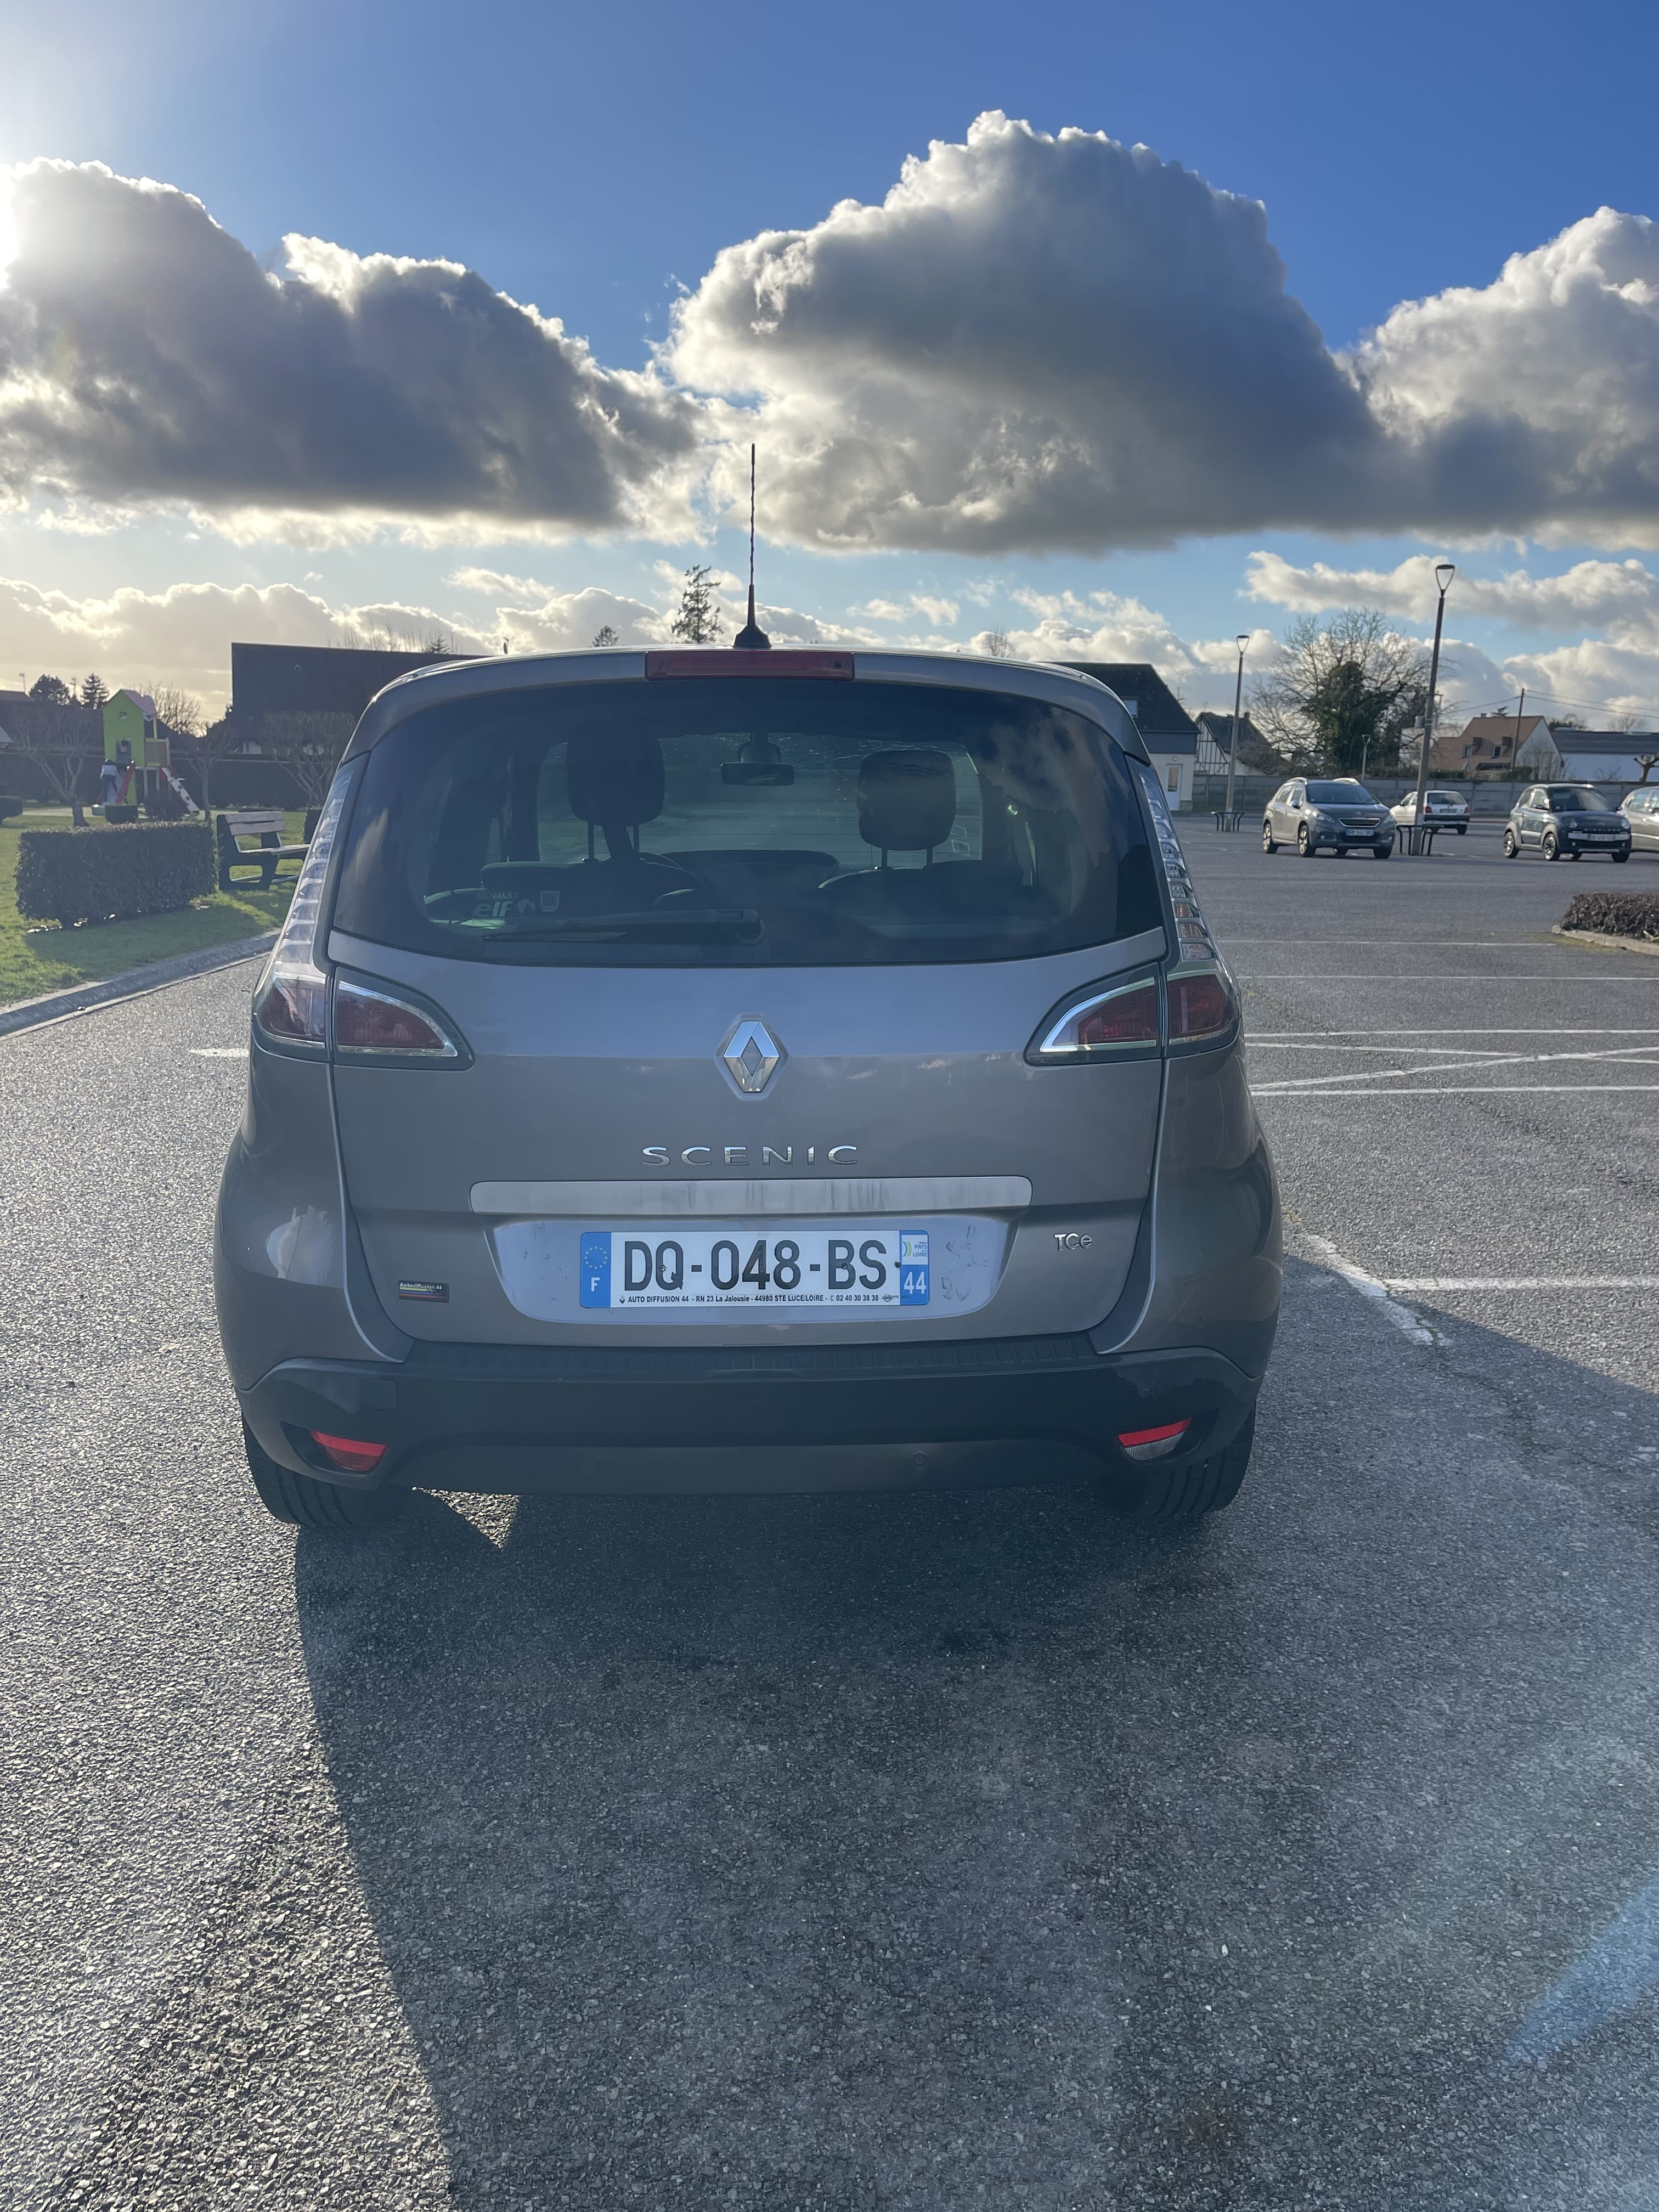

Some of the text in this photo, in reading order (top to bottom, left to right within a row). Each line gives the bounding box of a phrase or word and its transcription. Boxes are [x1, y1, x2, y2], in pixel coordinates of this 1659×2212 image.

[475, 901, 513, 917] elf
[641, 1145, 857, 1167] SCENIC
[1054, 1233, 1092, 1250] TCe
[624, 1240, 887, 1291] DQ-048-BS
[591, 1277, 600, 1292] F
[904, 1271, 927, 1294] 44
